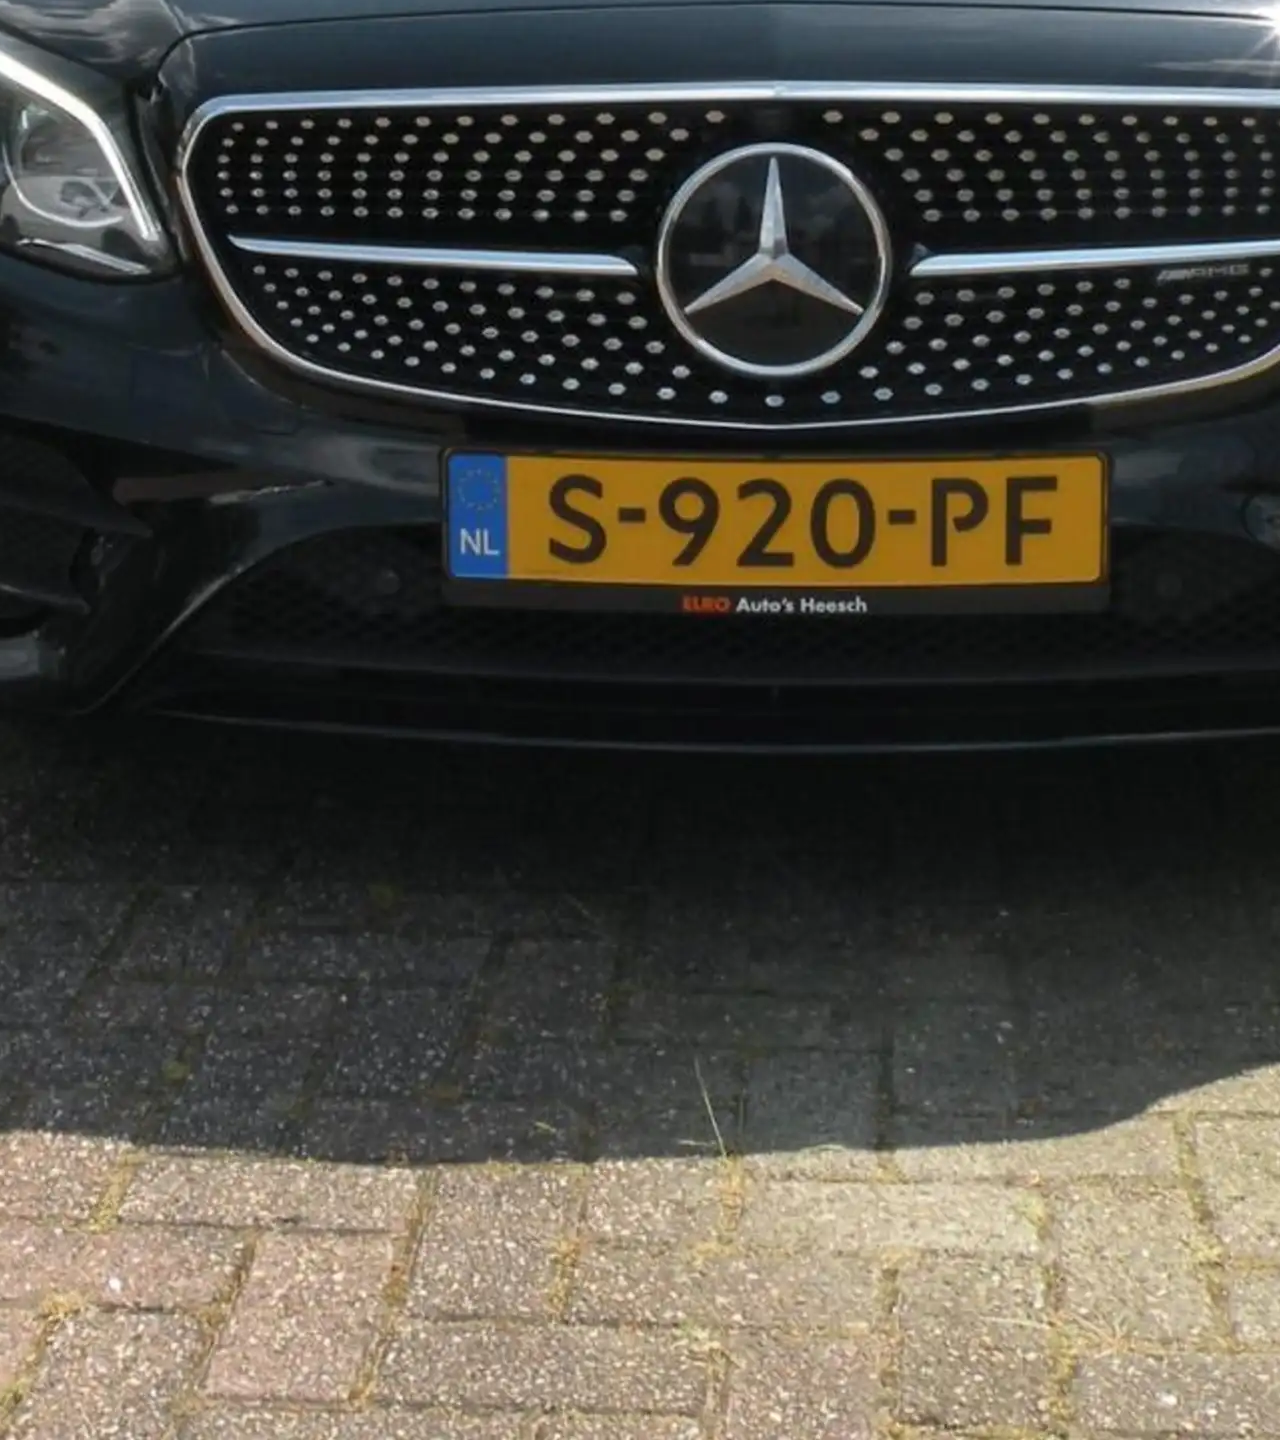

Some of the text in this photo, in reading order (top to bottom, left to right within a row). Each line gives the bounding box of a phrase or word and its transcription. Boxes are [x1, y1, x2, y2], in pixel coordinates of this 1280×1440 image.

[459, 473, 1058, 569] NL S-920-PF
[736, 596, 794, 613] Auto's
